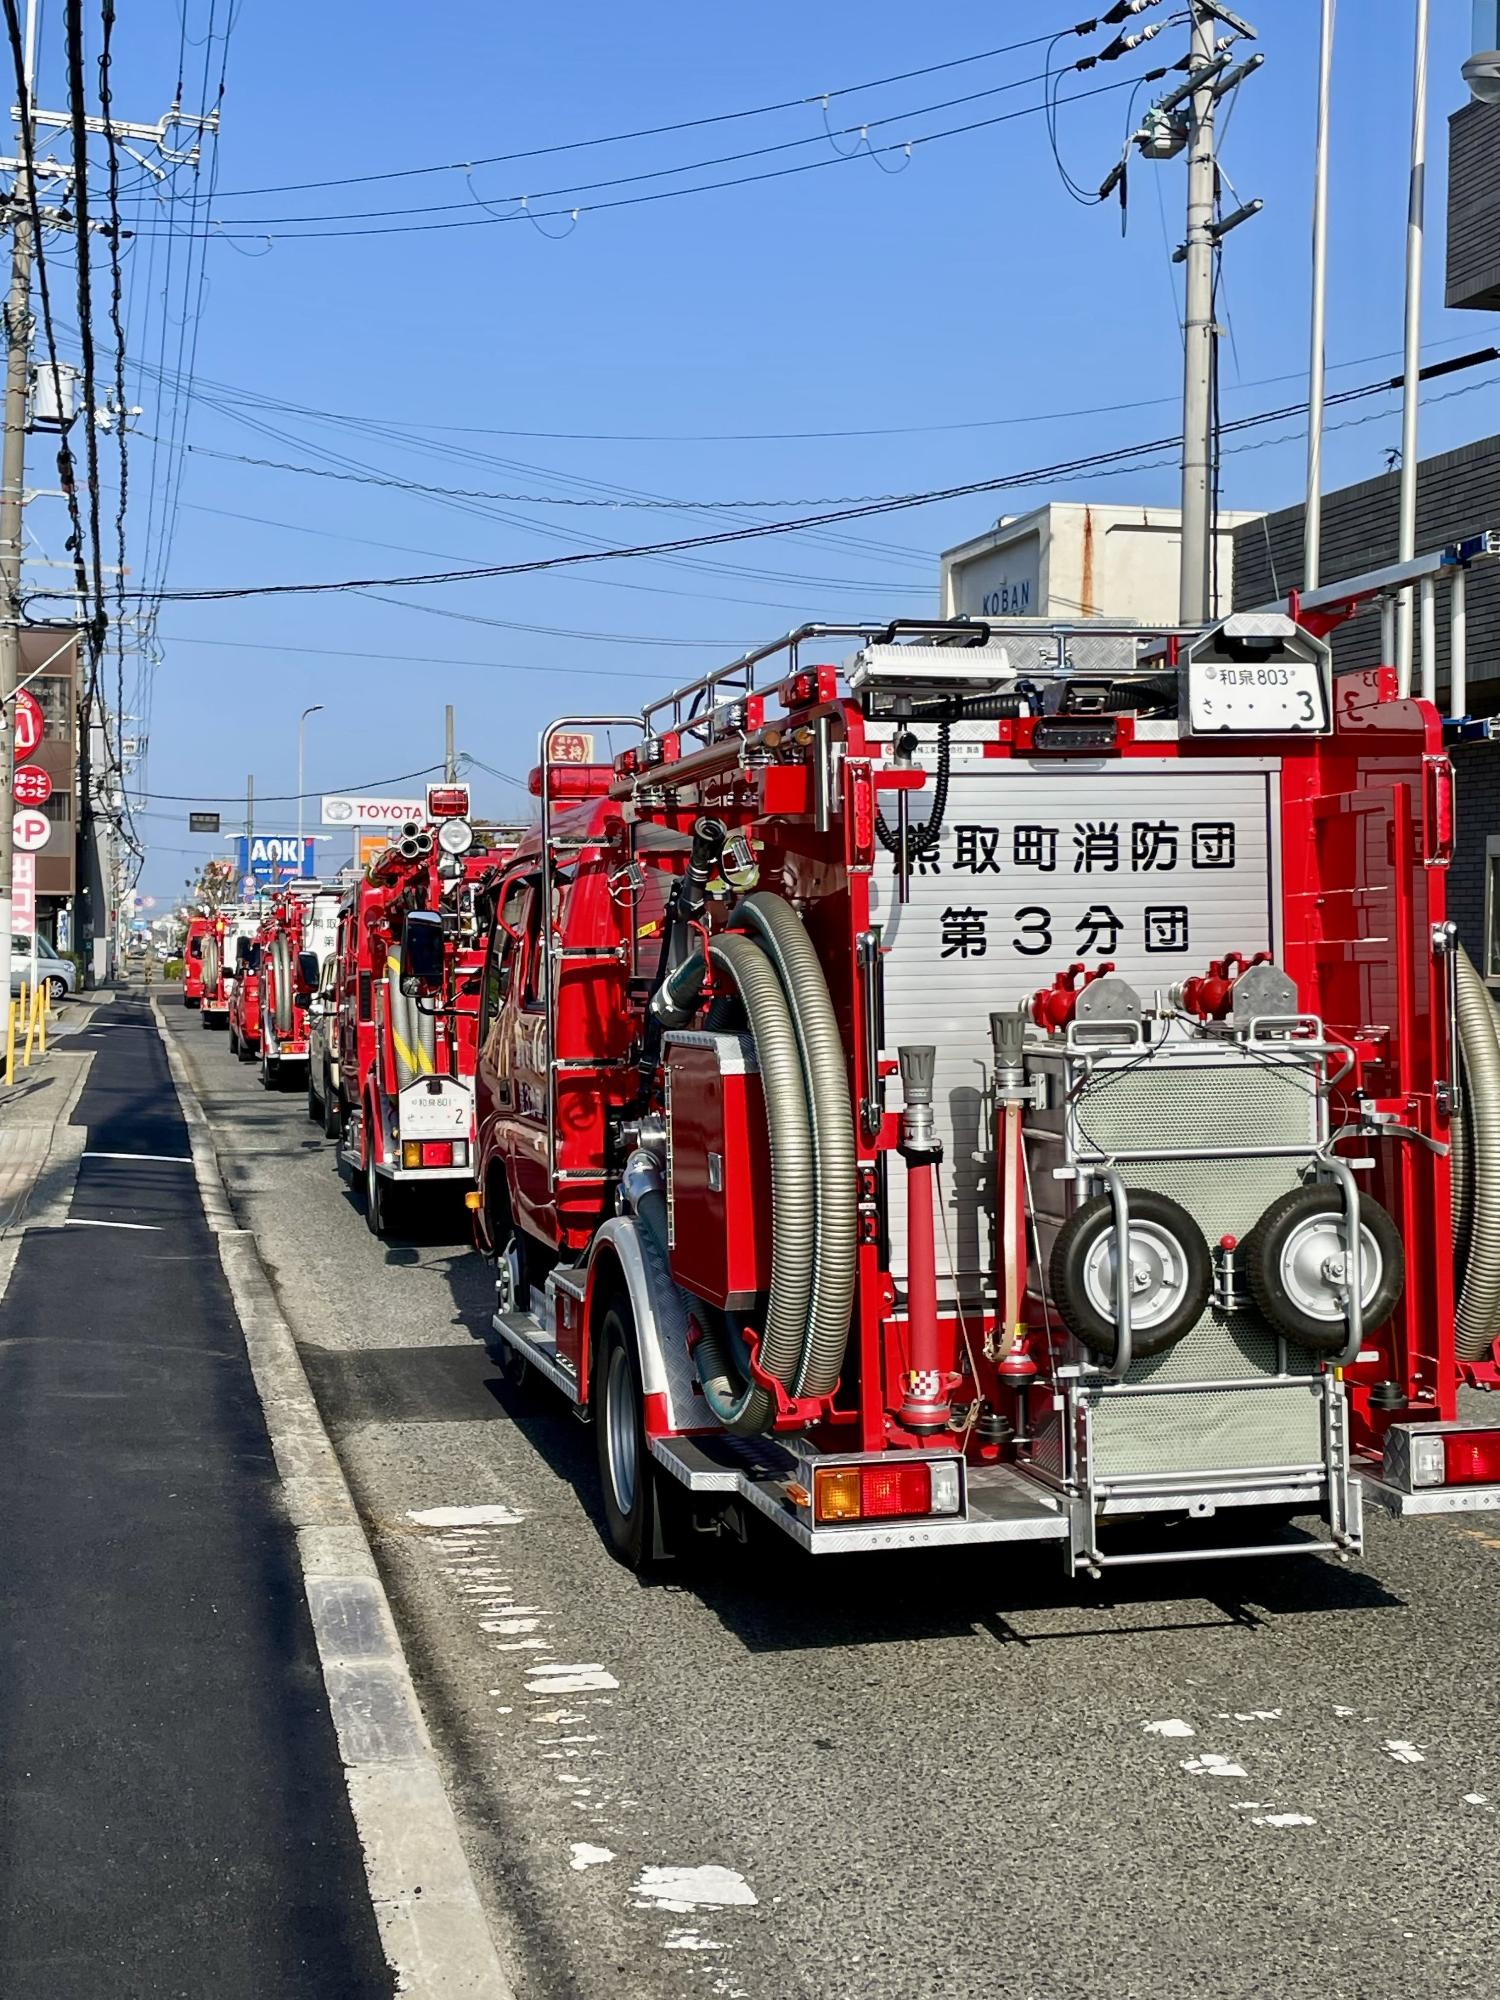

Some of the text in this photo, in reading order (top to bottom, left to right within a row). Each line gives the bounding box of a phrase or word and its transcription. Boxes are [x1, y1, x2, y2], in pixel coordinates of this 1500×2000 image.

[983, 580, 1030, 616] KOBAN
[1219, 669, 1289, 686] 和泉803
[553, 745, 582, 760] 王将
[14, 773, 47, 785] ほっと
[15, 786, 47, 798] もっと
[357, 805, 423, 819] TOYOTA
[25, 820, 45, 842] P
[251, 839, 304, 861] AOKI
